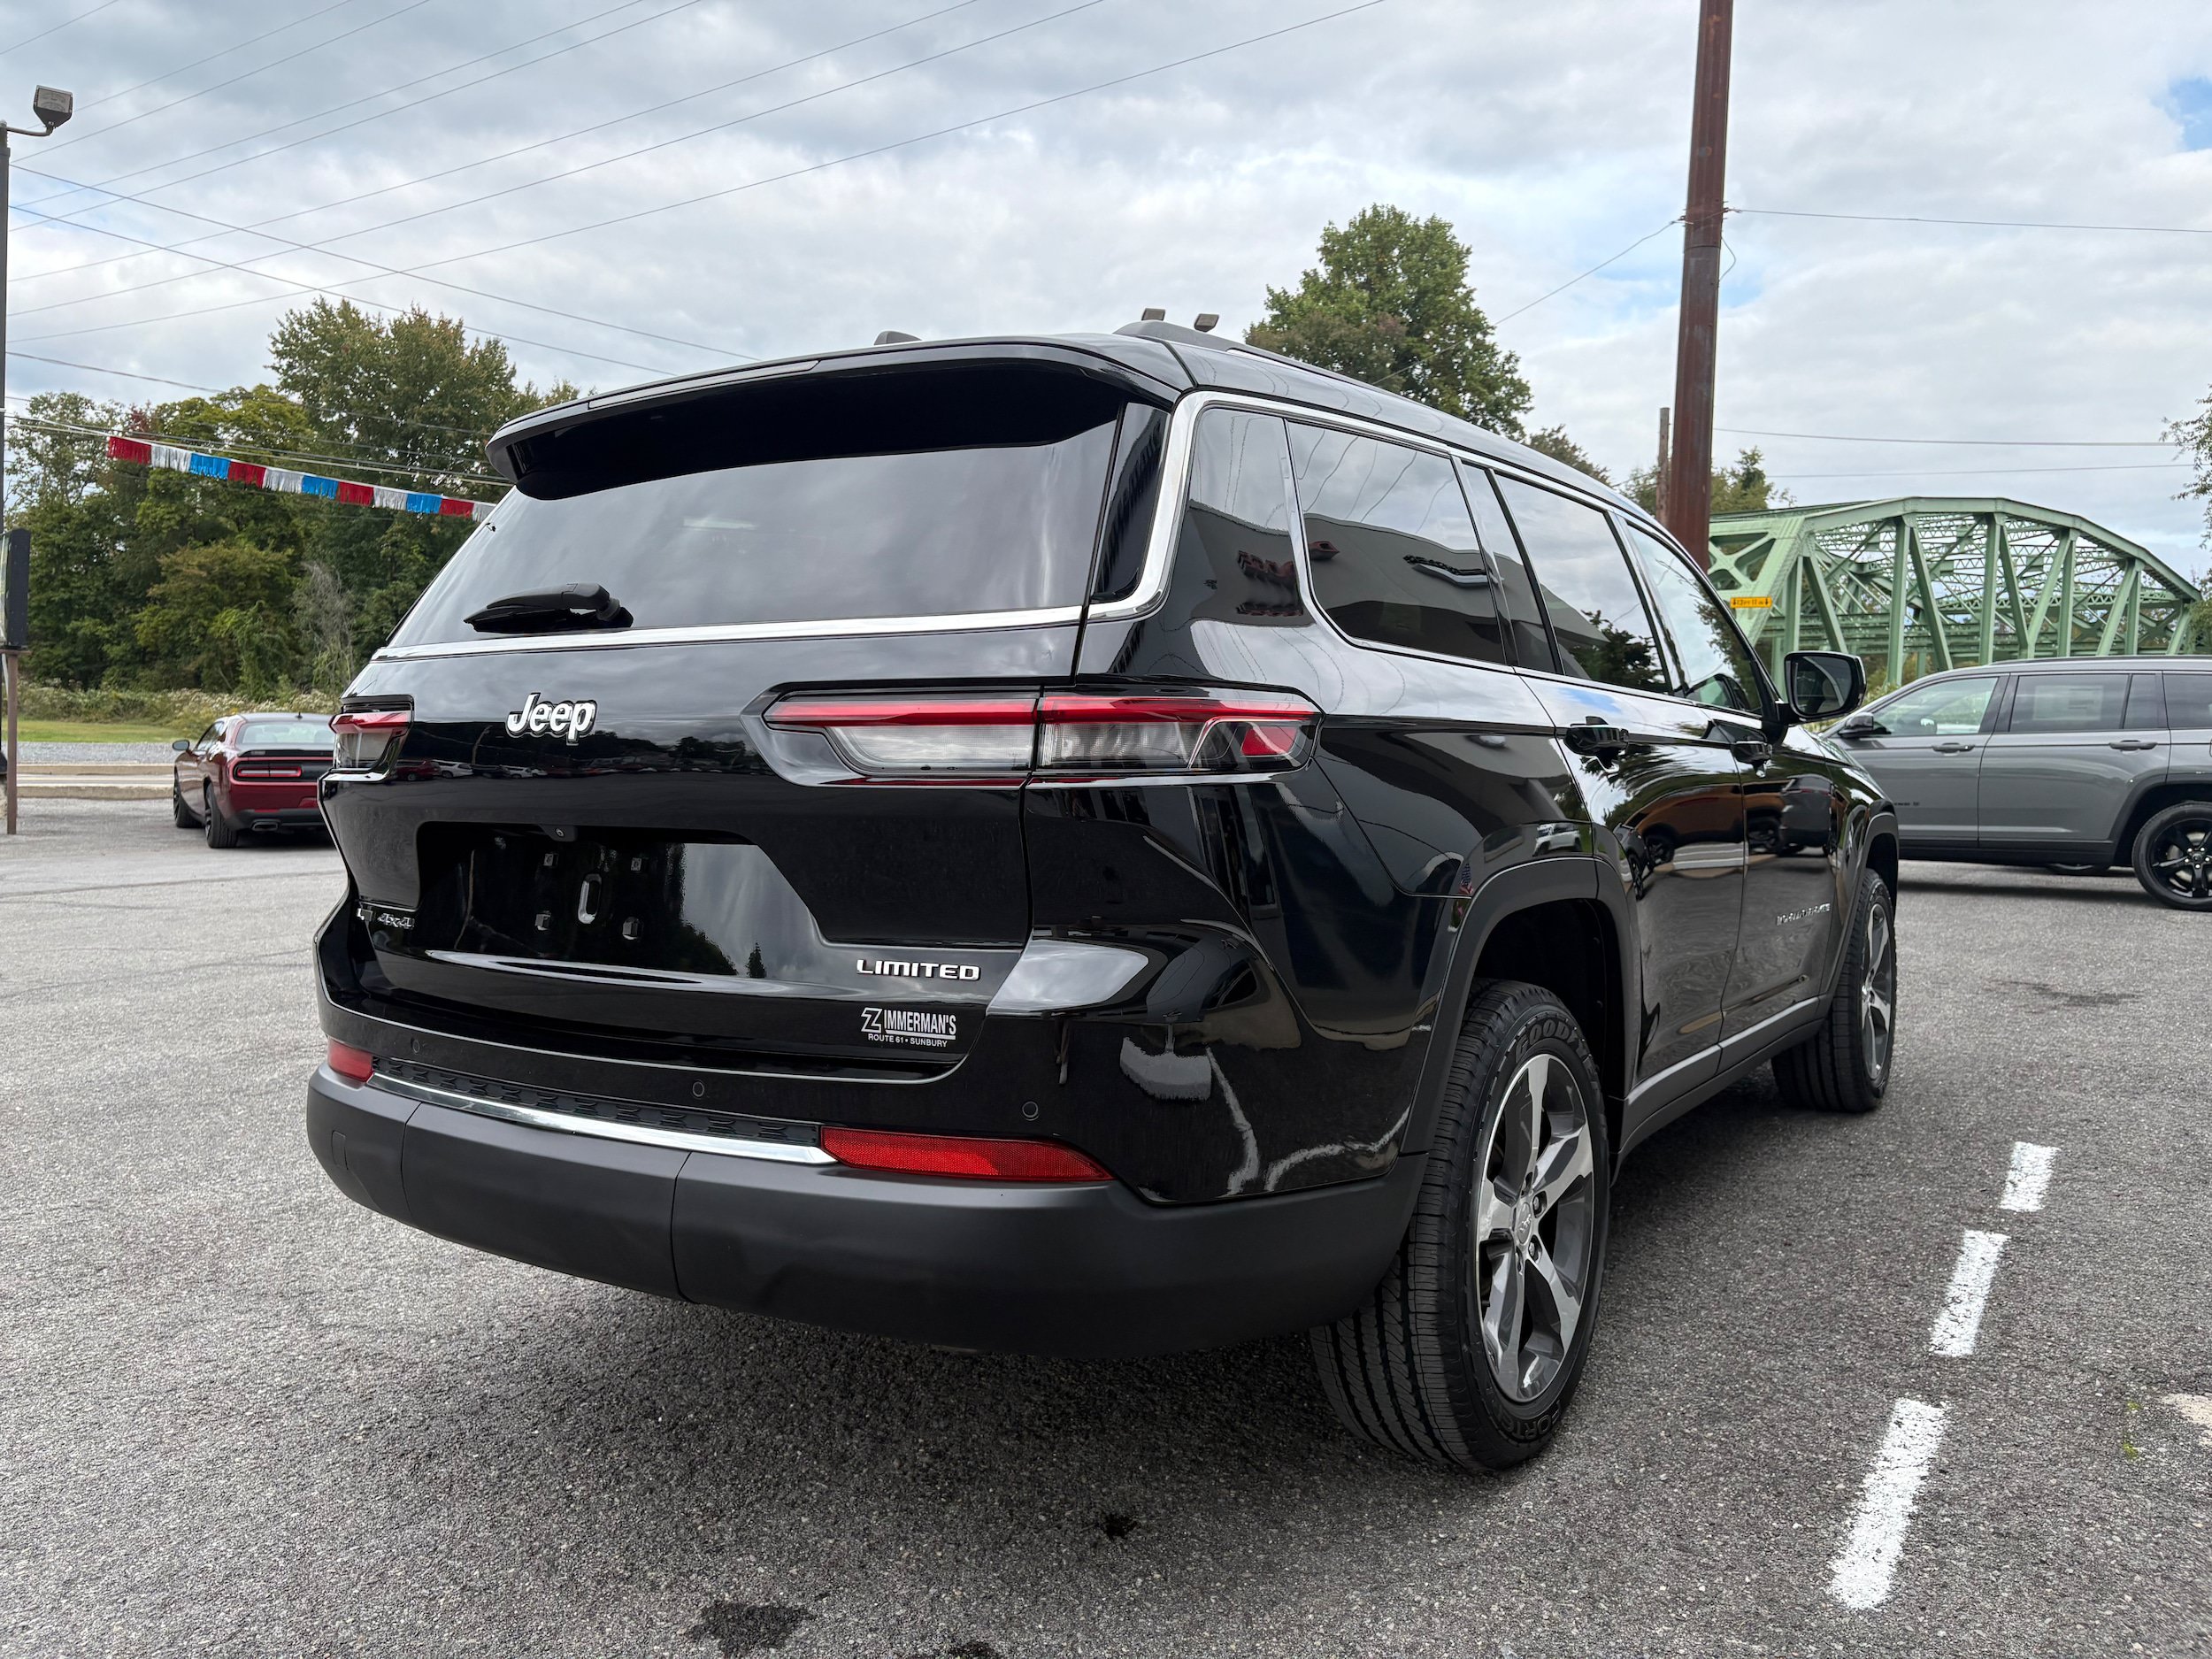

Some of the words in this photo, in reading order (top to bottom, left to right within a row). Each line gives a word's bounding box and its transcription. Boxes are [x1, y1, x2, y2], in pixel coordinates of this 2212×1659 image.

[506, 692, 597, 744] Jeep
[856, 959, 980, 980] LIMITED
[860, 1007, 956, 1035] ZIMMERMAN'S
[868, 1033, 894, 1043] ROUTE
[910, 1037, 948, 1048] SUNBURY
